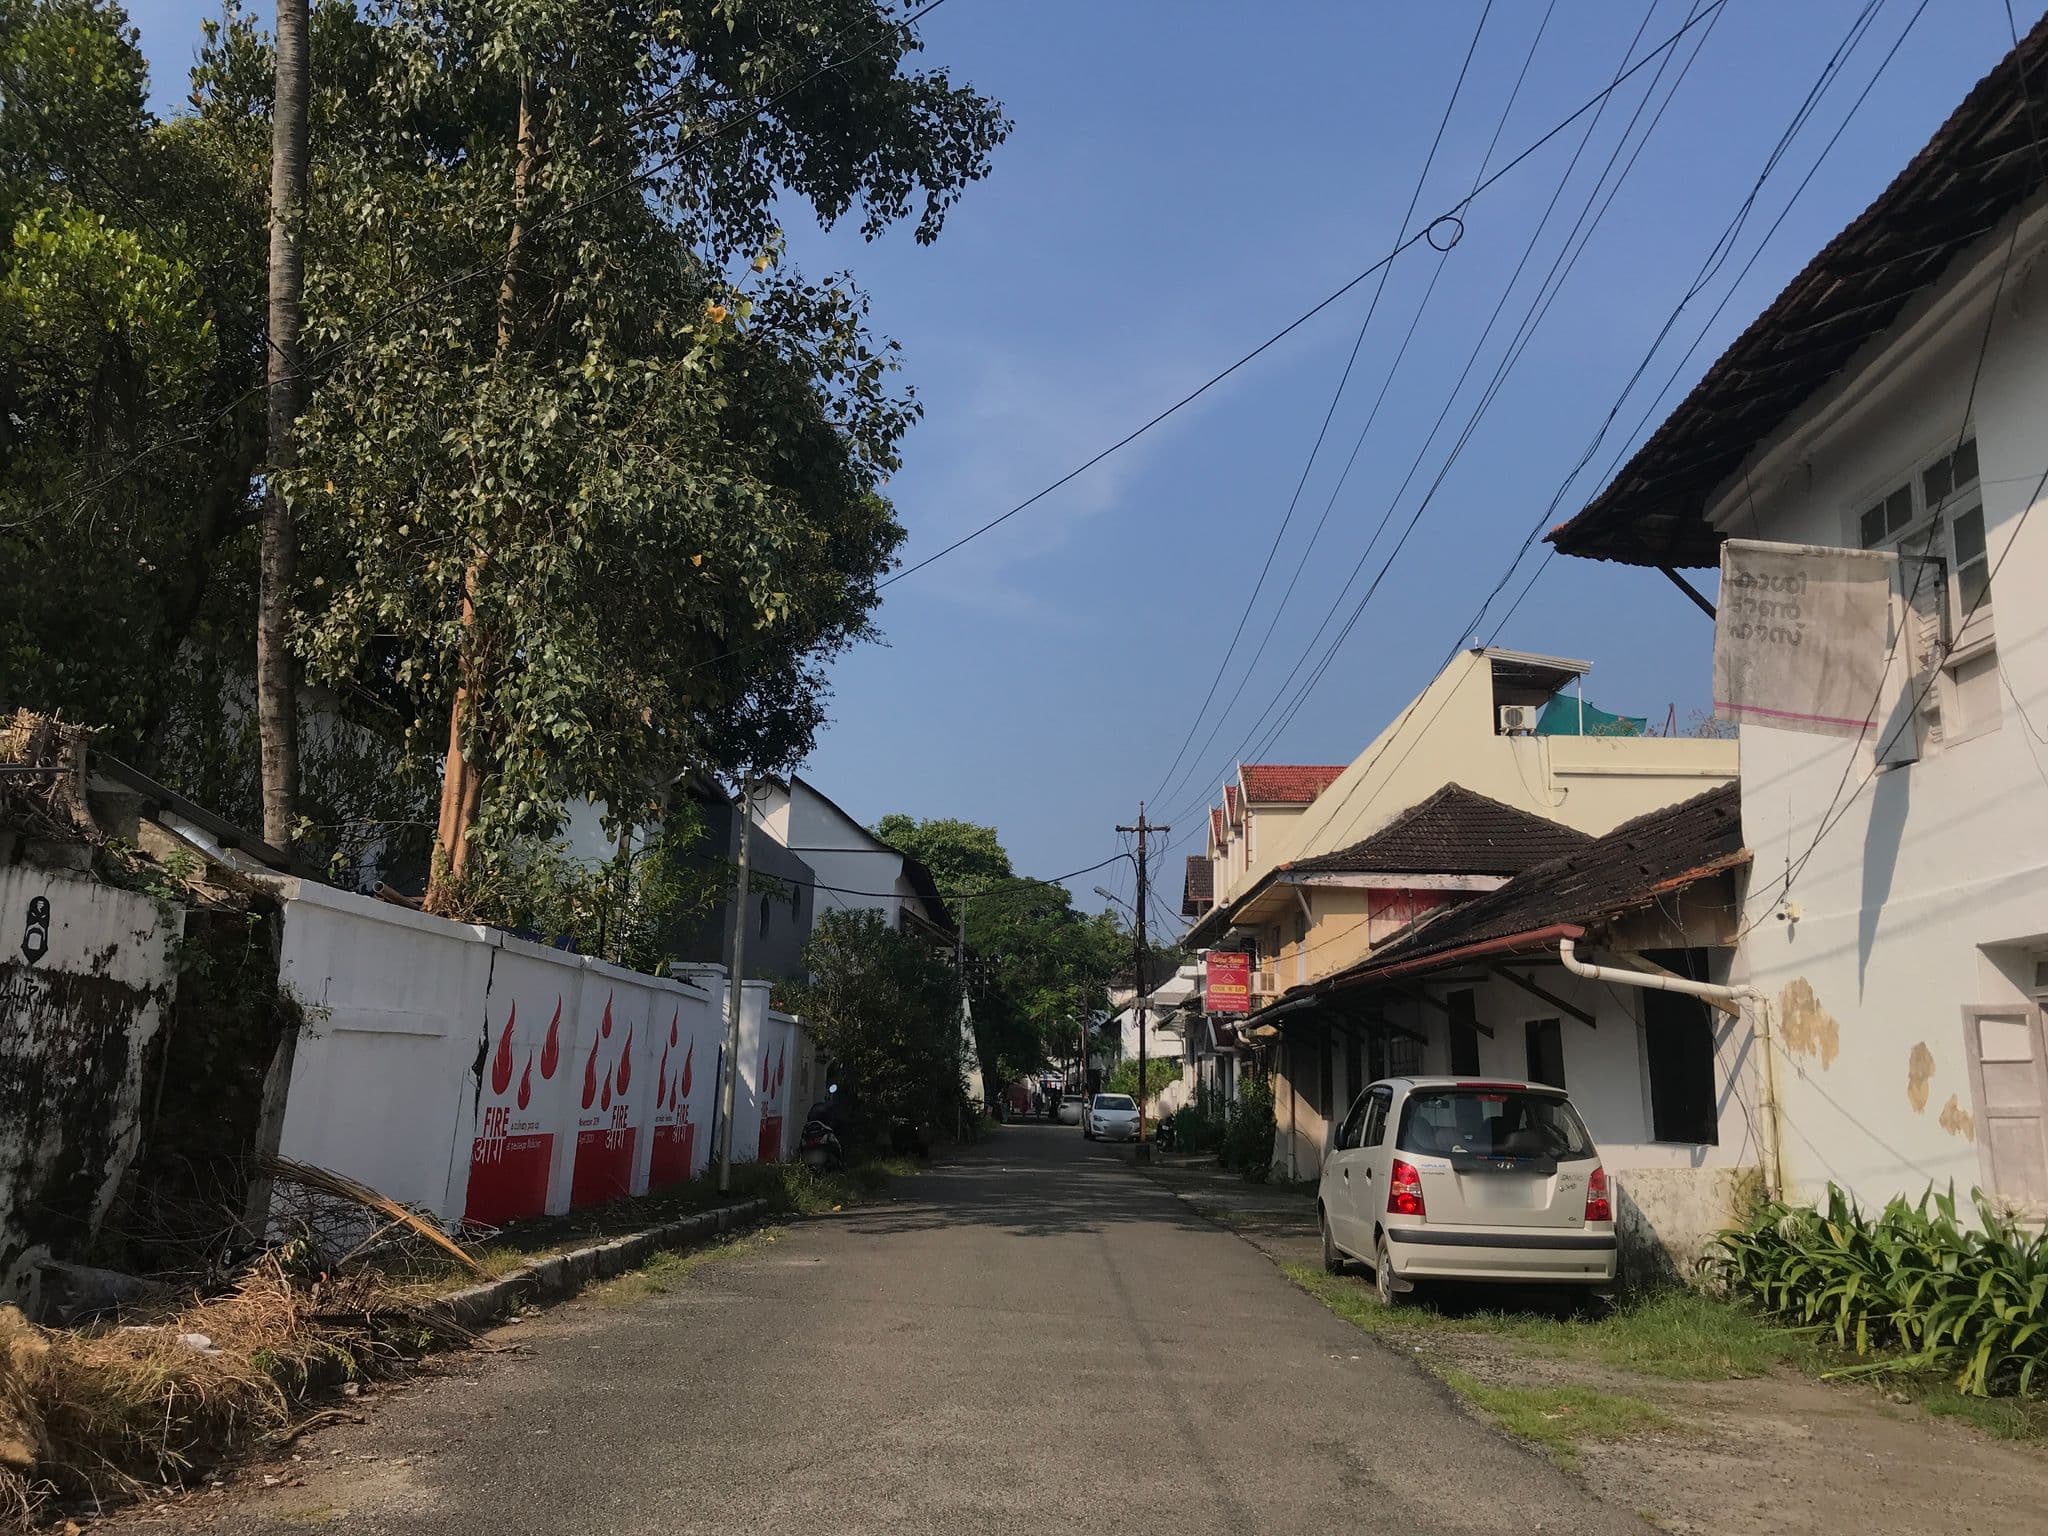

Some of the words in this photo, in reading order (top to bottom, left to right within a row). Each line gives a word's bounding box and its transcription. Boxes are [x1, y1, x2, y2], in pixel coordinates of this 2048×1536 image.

[483, 1107, 510, 1138] FIRE
[611, 1105, 629, 1129] FIRE
[675, 1104, 690, 1125] FIRE
[605, 1128, 627, 1151] आग
[672, 1124, 688, 1144] आग
[473, 1136, 507, 1165] आग
